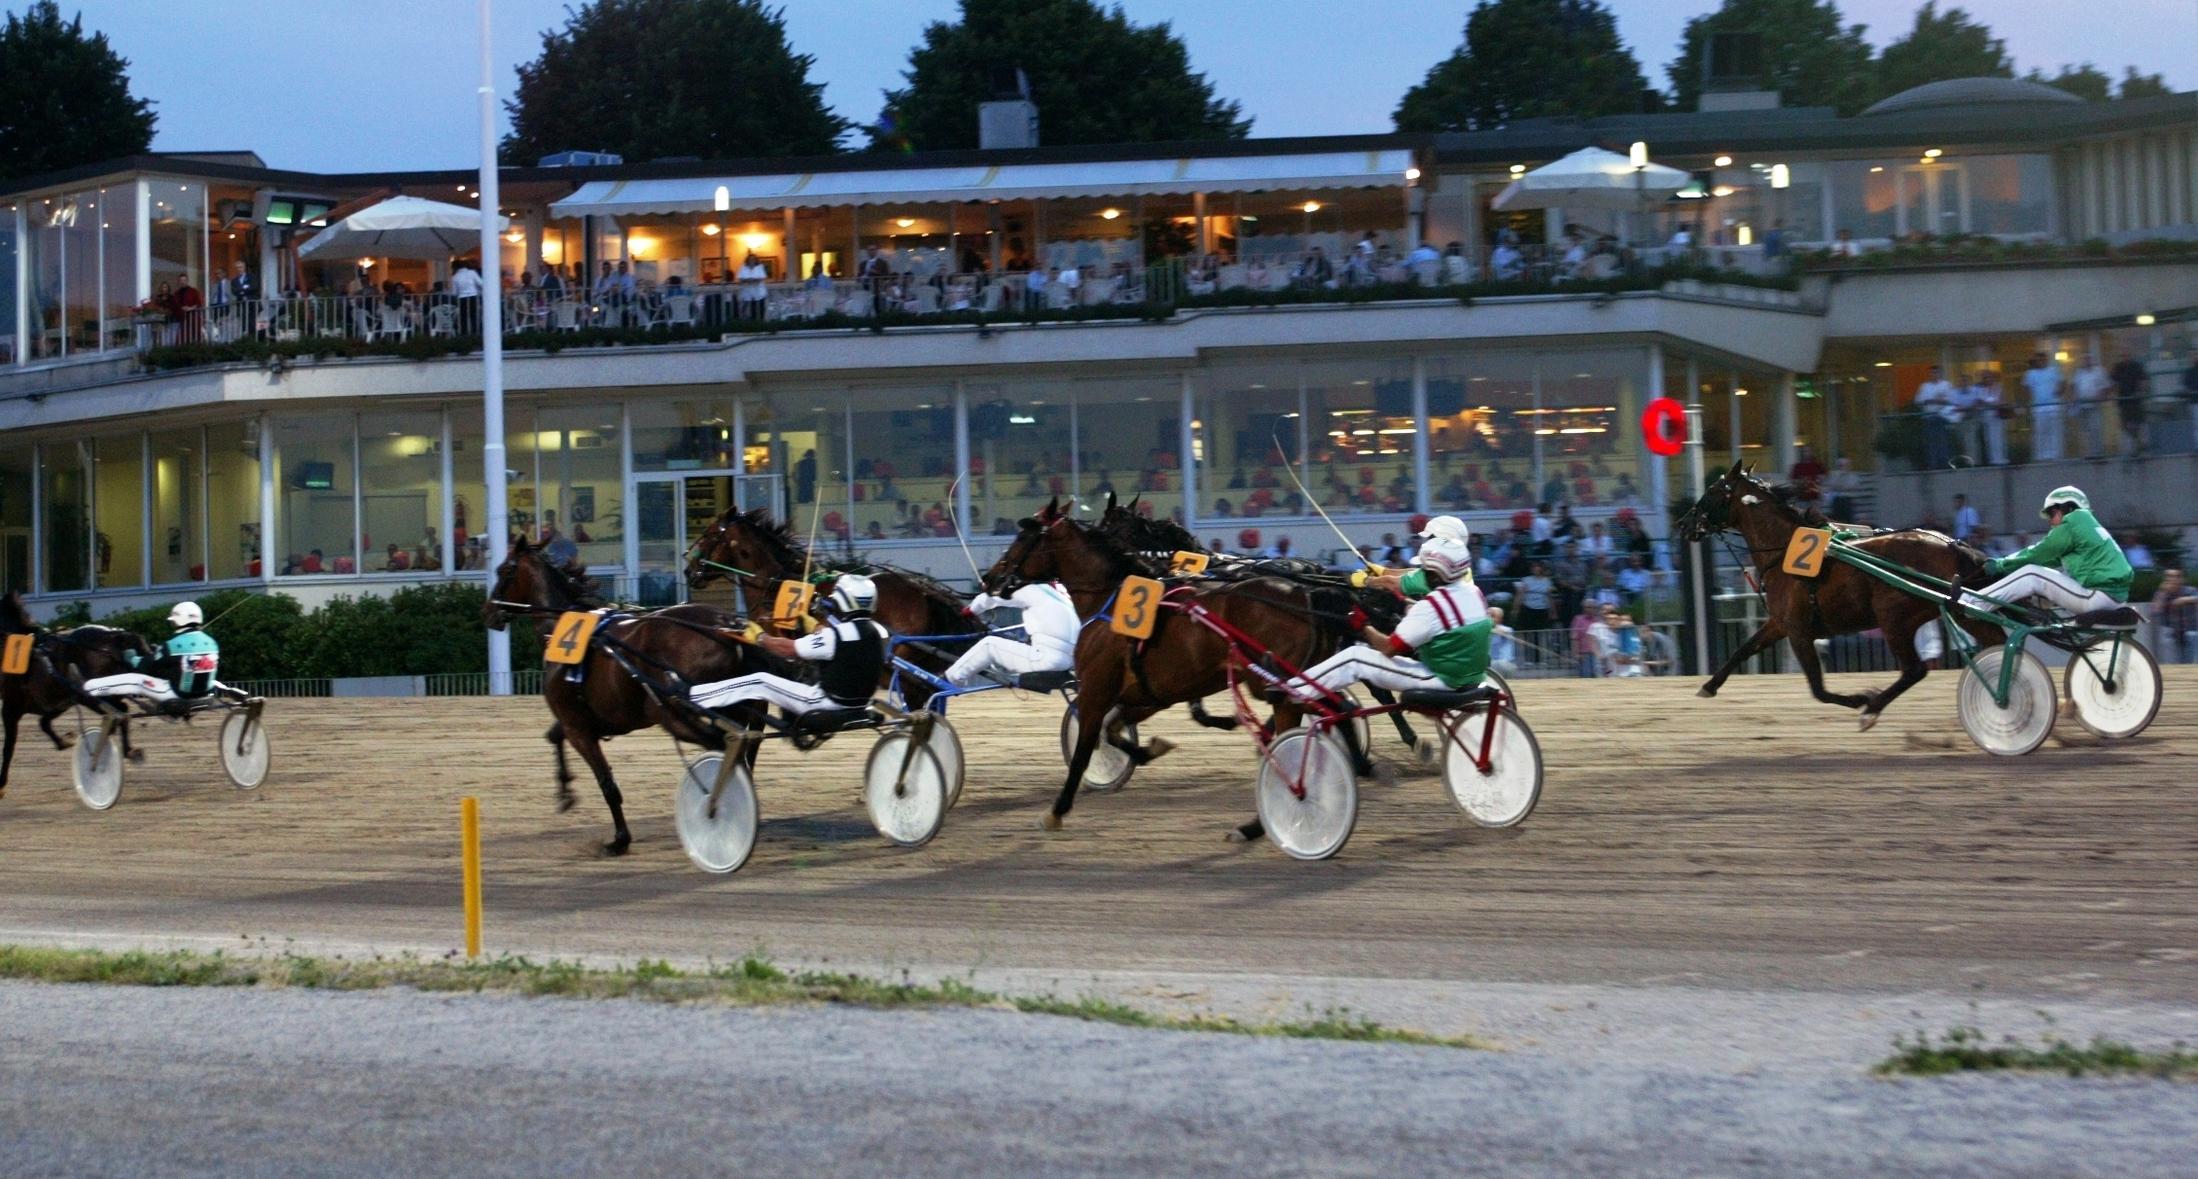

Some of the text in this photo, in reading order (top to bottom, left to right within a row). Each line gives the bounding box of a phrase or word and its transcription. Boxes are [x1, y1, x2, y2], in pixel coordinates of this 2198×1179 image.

[1791, 533, 1820, 571] 2
[783, 587, 803, 619] 7
[1123, 585, 1149, 629] 3
[556, 618, 585, 657] 4
